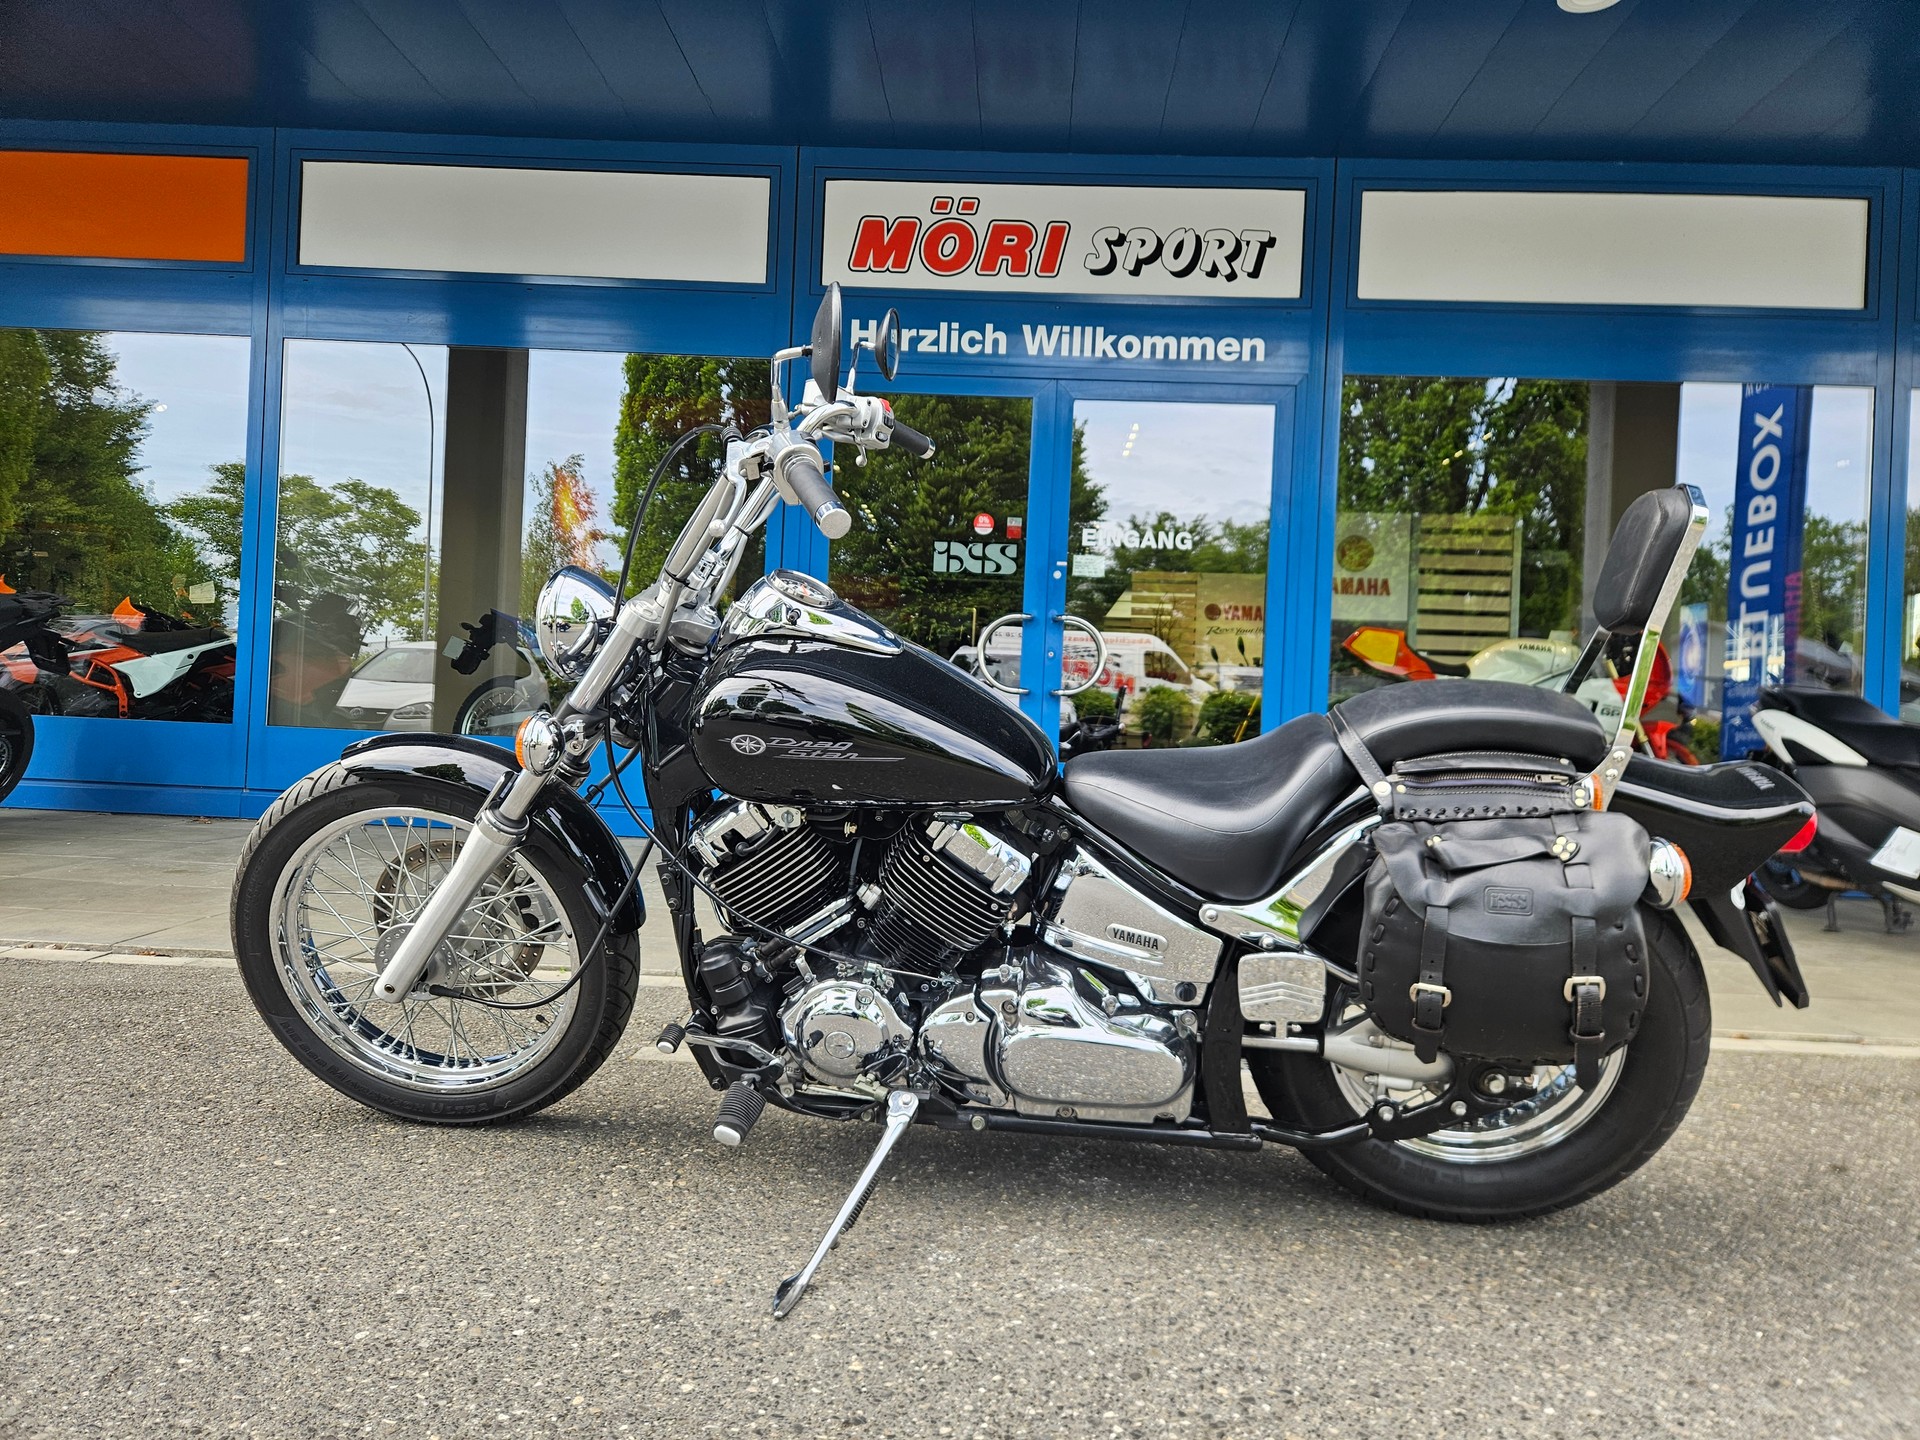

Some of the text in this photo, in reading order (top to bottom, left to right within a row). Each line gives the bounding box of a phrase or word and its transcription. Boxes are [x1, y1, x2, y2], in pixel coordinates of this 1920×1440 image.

[847, 196, 1277, 282] MÖRI SPORT
[850, 318, 1266, 362] Hrzlich Willkommen
[1081, 528, 1193, 550] EINGANG
[1332, 577, 1391, 597] AMAHA
[1223, 605, 1263, 621] YAMA
[768, 737, 853, 750] Drag
[783, 748, 862, 760] Star
[1112, 927, 1159, 951] YAMAHA
